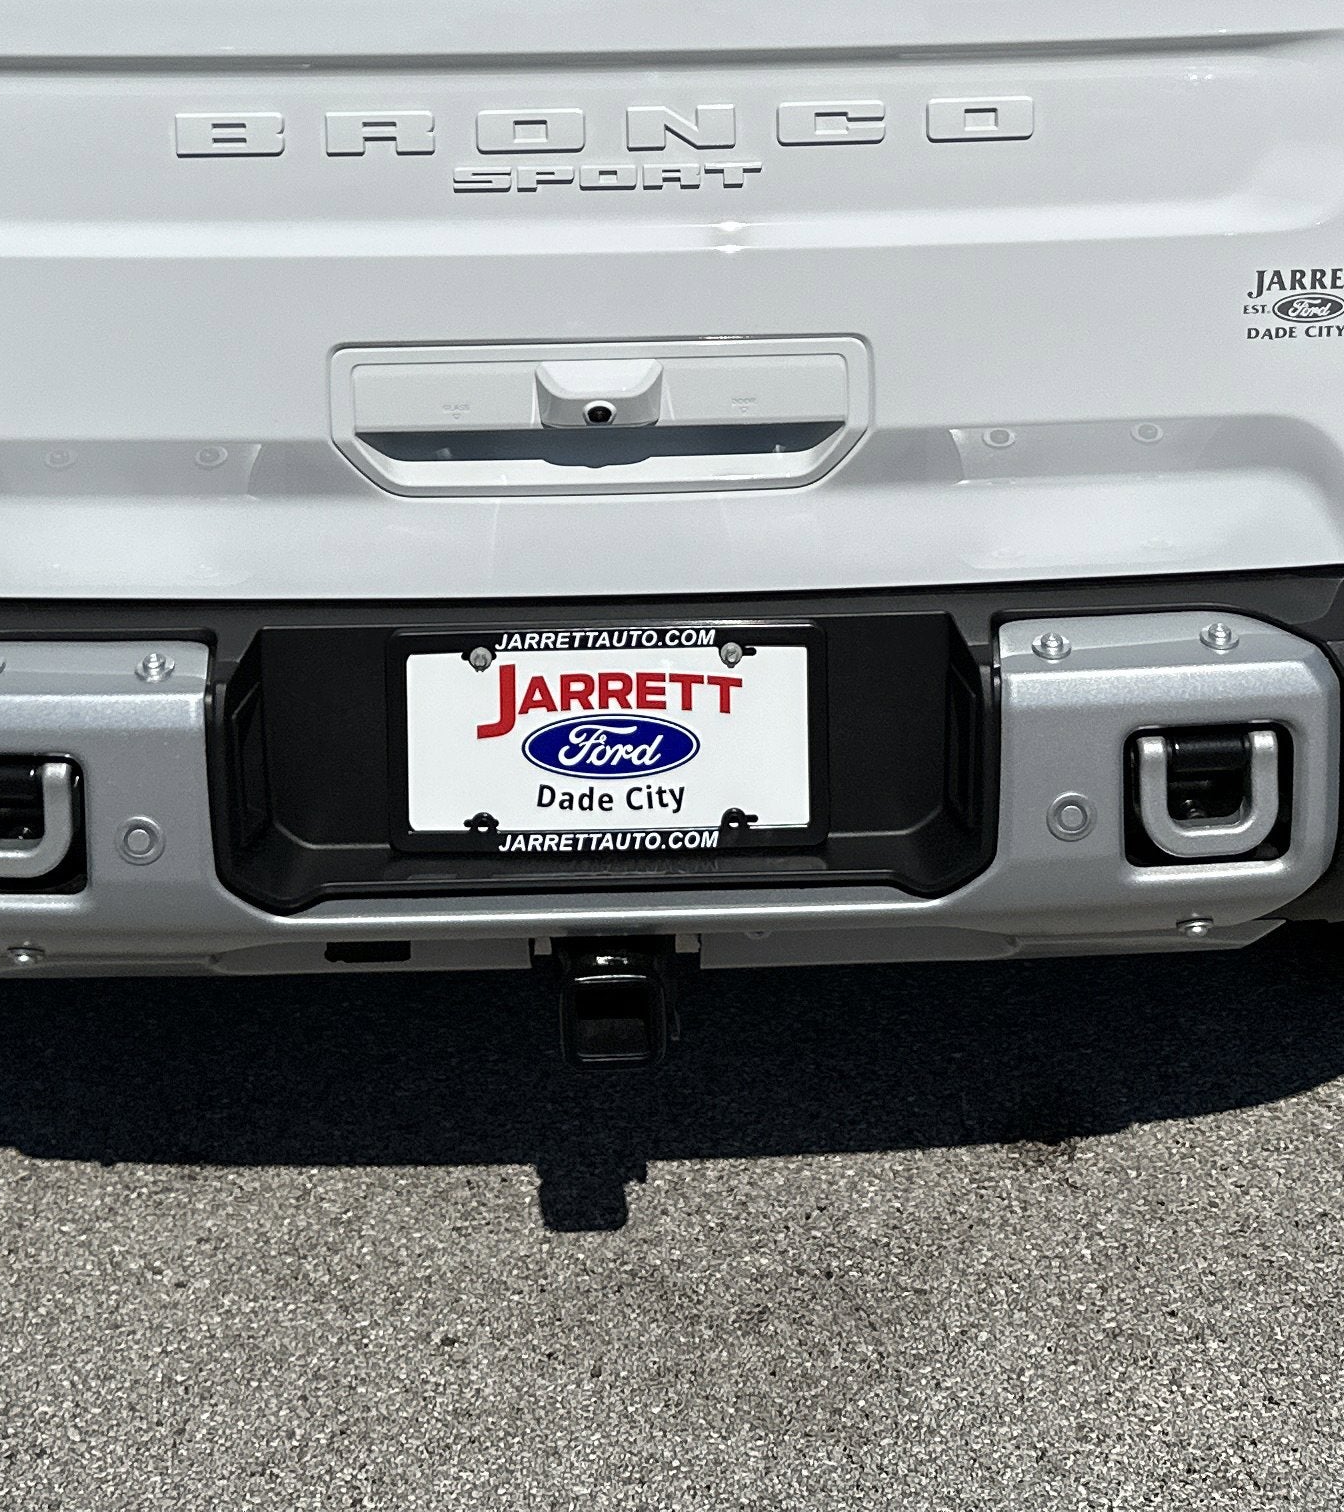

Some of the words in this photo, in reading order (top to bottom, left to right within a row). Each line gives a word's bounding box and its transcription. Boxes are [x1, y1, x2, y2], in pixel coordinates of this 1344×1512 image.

[174, 95, 1035, 158] BRONCO
[452, 160, 762, 193] SPORT
[1243, 304, 1270, 315] EST.
[1288, 297, 1331, 318] Ford
[1246, 326, 1298, 341] DADE
[494, 628, 716, 651] JARRETTAUTO.COM
[476, 664, 743, 739] JARRETT
[558, 723, 665, 767] Ford
[536, 784, 615, 812] Dade
[625, 783, 687, 814] City
[498, 830, 720, 853] JARRETTAUTO.COM
